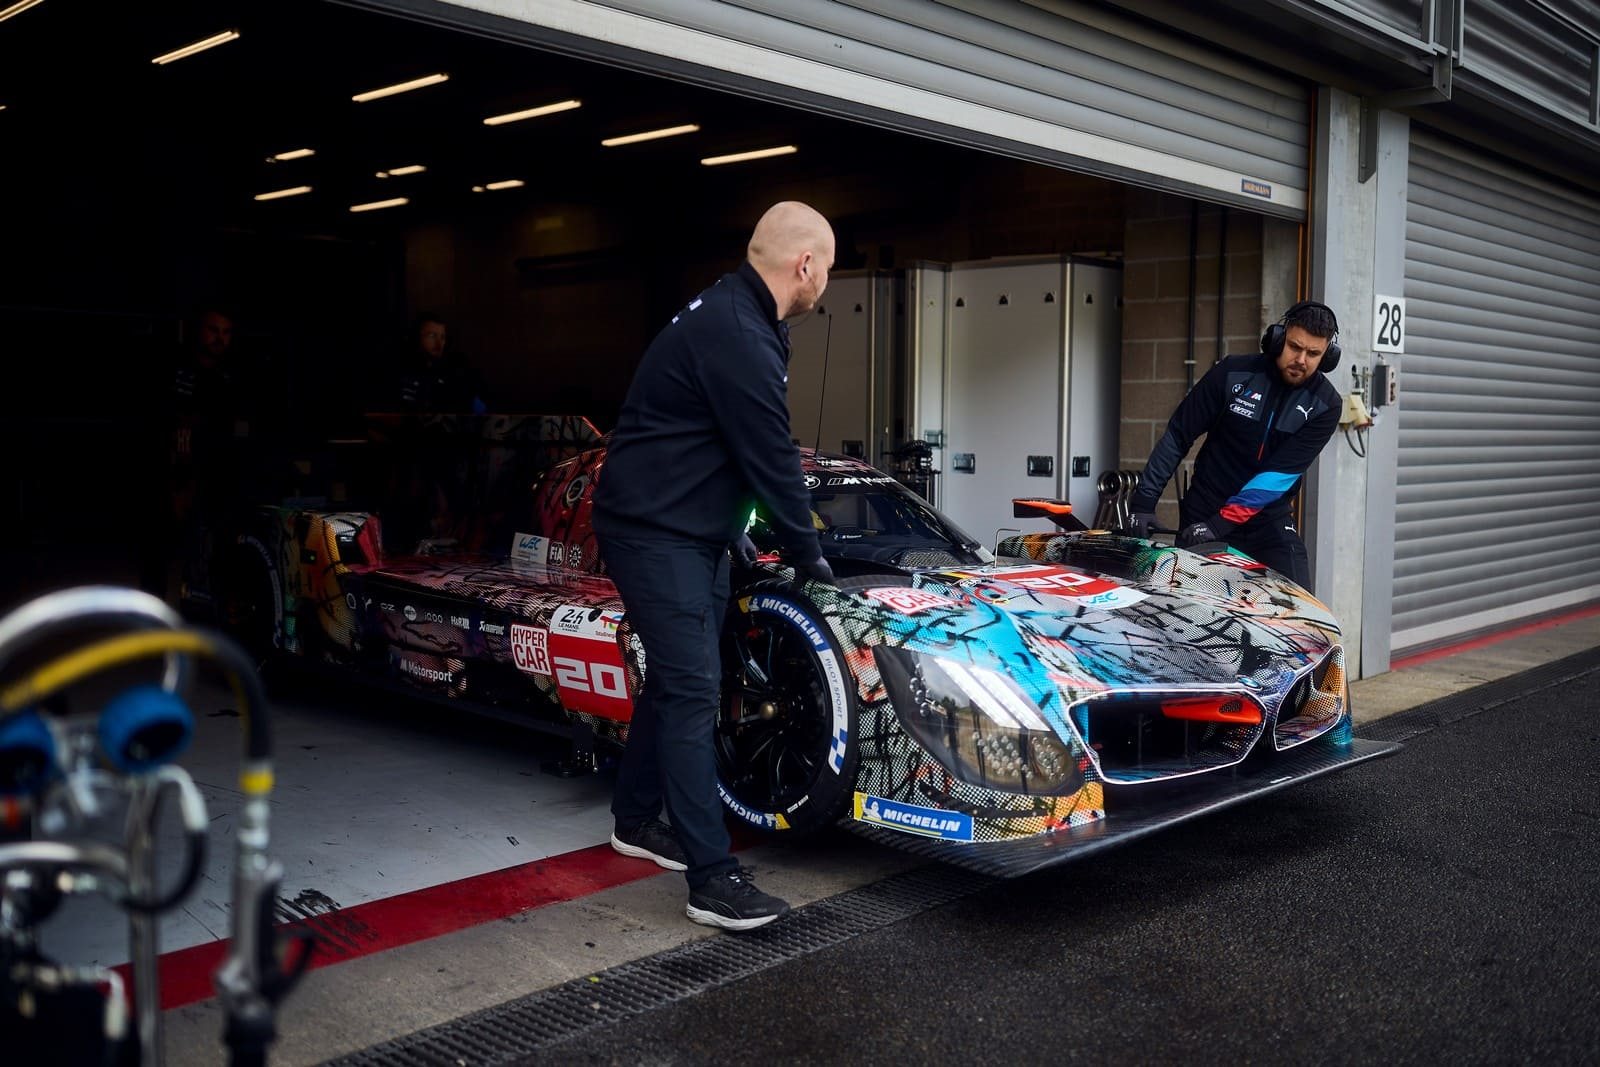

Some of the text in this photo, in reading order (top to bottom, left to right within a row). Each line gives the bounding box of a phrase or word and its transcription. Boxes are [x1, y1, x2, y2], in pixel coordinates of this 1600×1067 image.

[1377, 302, 1401, 347] 28
[519, 537, 542, 550] WEC
[550, 545, 563, 561] FIA
[1009, 572, 1096, 588] 20
[761, 598, 824, 647] MICHELIN
[512, 629, 545, 648] HYPER
[407, 660, 453, 682] Motorsport
[513, 645, 549, 672] CAR
[553, 656, 628, 700] 20
[825, 658, 843, 718] PILOT SPORT
[717, 783, 763, 825] MICHEL
[882, 808, 961, 832] MICHELIN
